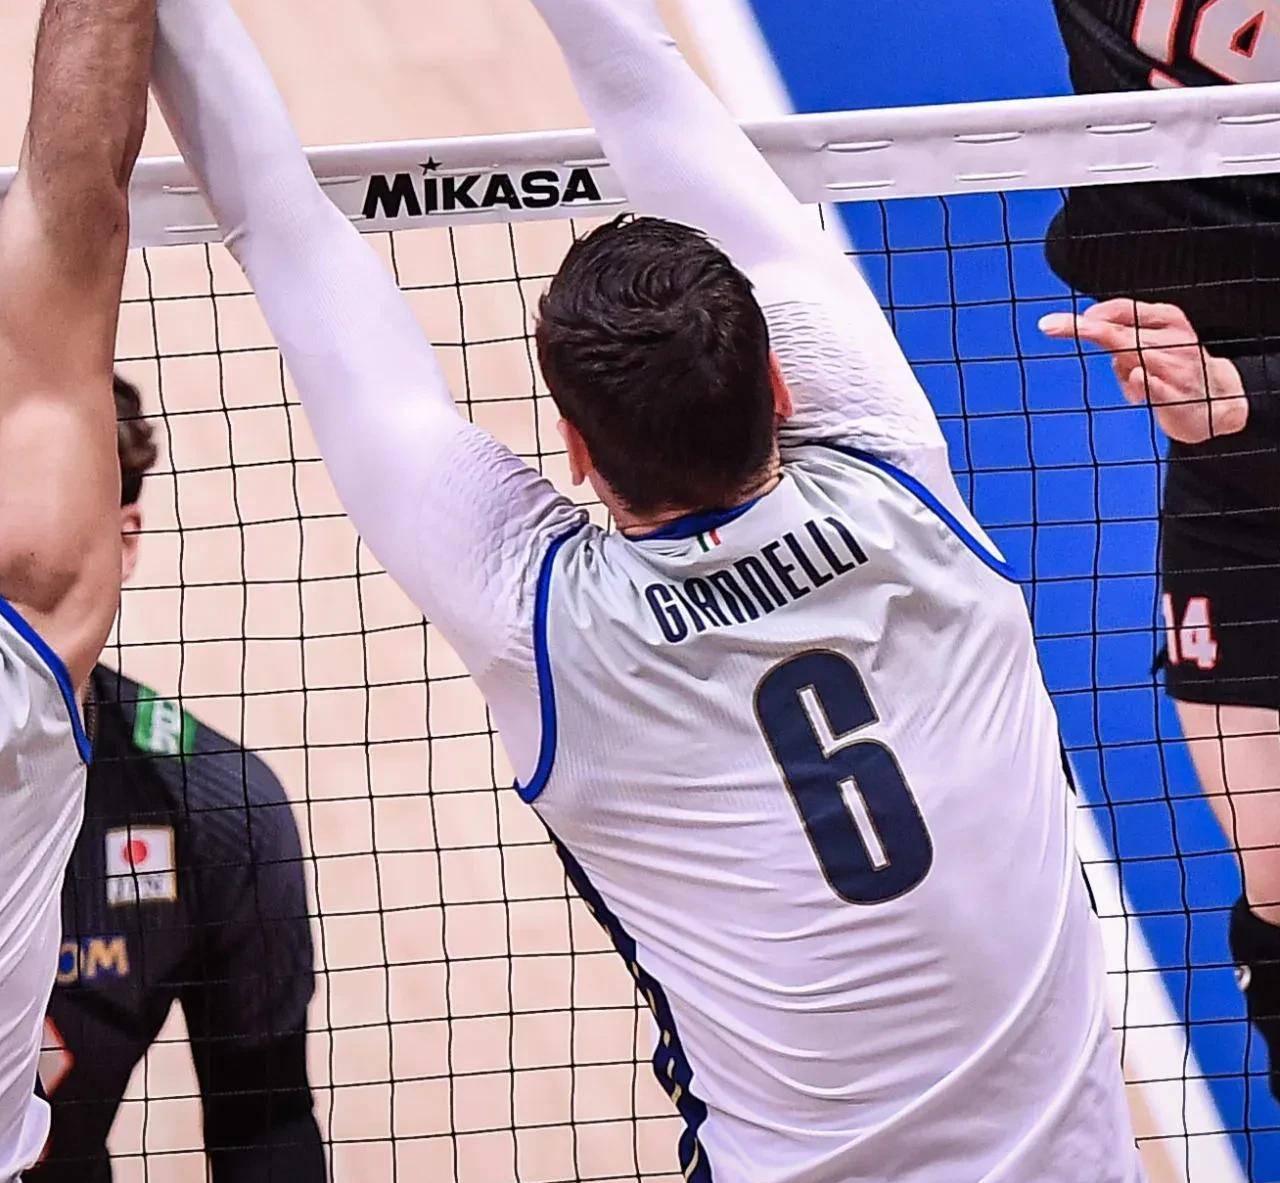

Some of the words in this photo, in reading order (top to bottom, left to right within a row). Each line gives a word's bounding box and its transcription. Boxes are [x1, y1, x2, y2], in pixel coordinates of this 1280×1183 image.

[361, 157, 602, 219] MIKASA
[644, 516, 869, 644] GIANNELLI
[1161, 592, 1220, 671] 14
[752, 648, 934, 906] 6
